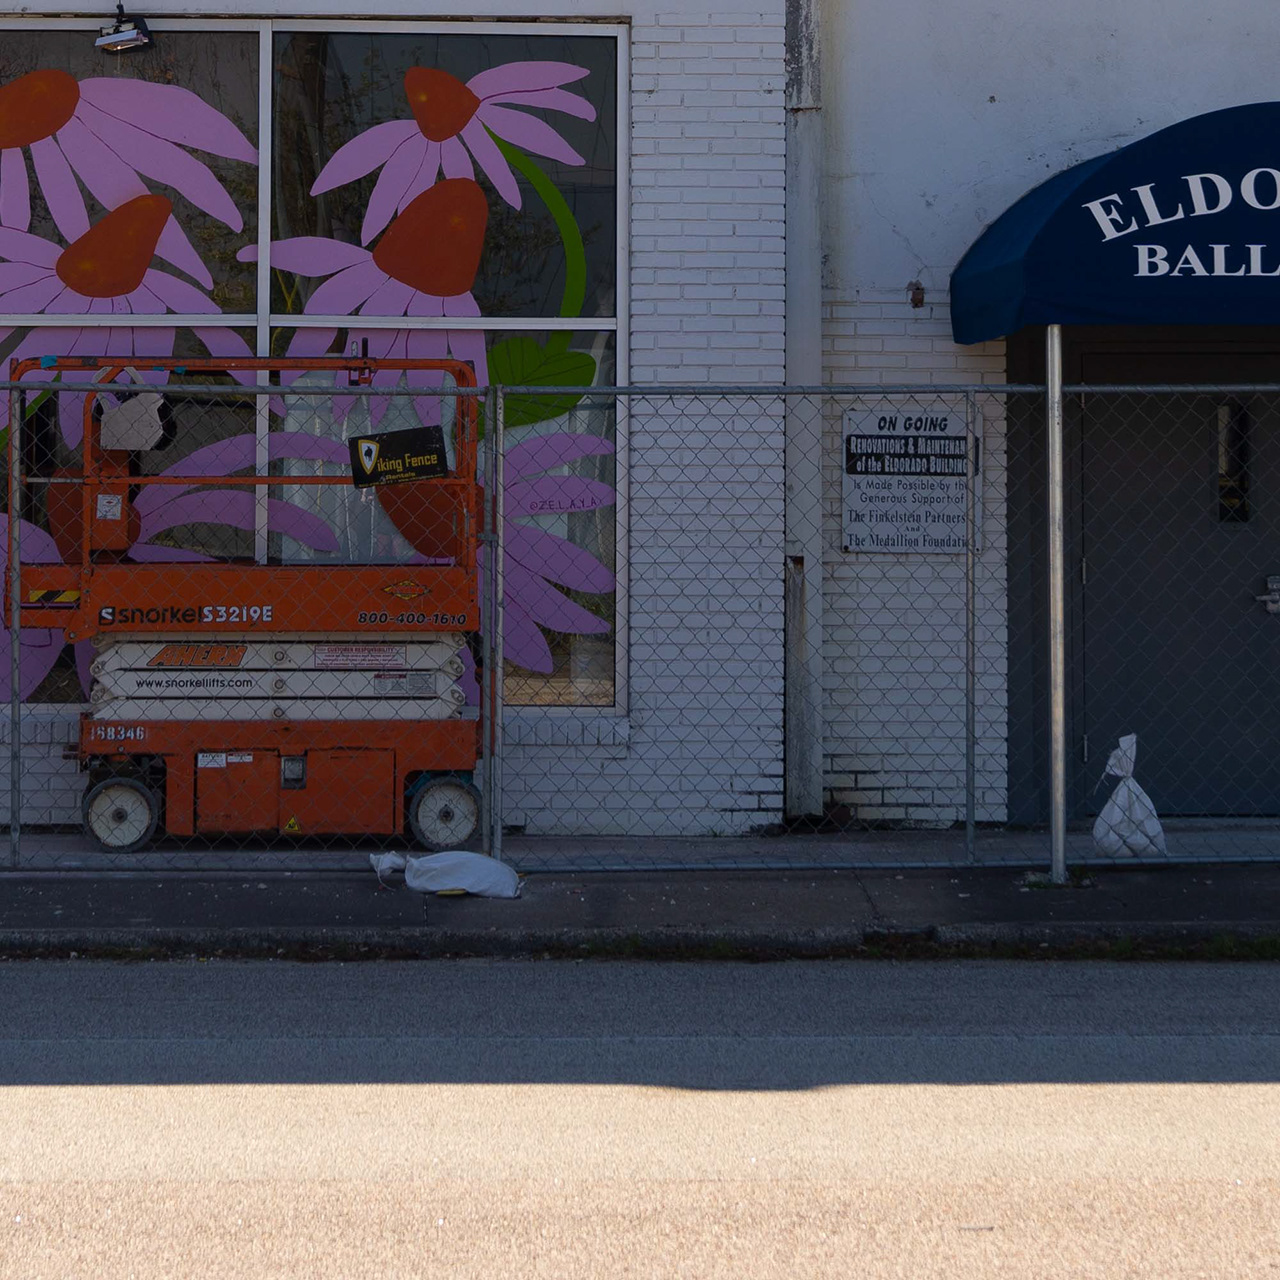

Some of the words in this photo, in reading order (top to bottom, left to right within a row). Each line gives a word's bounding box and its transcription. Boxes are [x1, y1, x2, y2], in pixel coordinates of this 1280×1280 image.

[877, 416, 897, 431] ON
[904, 416, 948, 432] GOING
[850, 436, 905, 454] RENOVATIONS
[907, 437, 915, 454] &
[917, 437, 966, 454] MAINTENAN
[404, 453, 438, 468] Fence
[856, 456, 866, 472] of
[868, 456, 882, 472] the
[885, 456, 928, 472] ELDORADO
[853, 480, 861, 490] Is
[865, 480, 892, 490] Made
[897, 480, 935, 490] Possible
[939, 480, 951, 493] by
[859, 493, 907, 503] Generous
[911, 493, 950, 506] Support
[954, 494, 965, 503] of
[847, 509, 865, 522] The
[868, 509, 921, 523] Finkelstein
[847, 533, 866, 547] The
[869, 533, 919, 547] Medallion
[922, 534, 967, 548] Foundati
[118, 606, 203, 624] snorkel
[203, 606, 273, 623] S3219E
[357, 612, 467, 626] 800-400-1610
[146, 645, 248, 667] AHERN
[136, 677, 253, 688] www.snorkellifts.com
